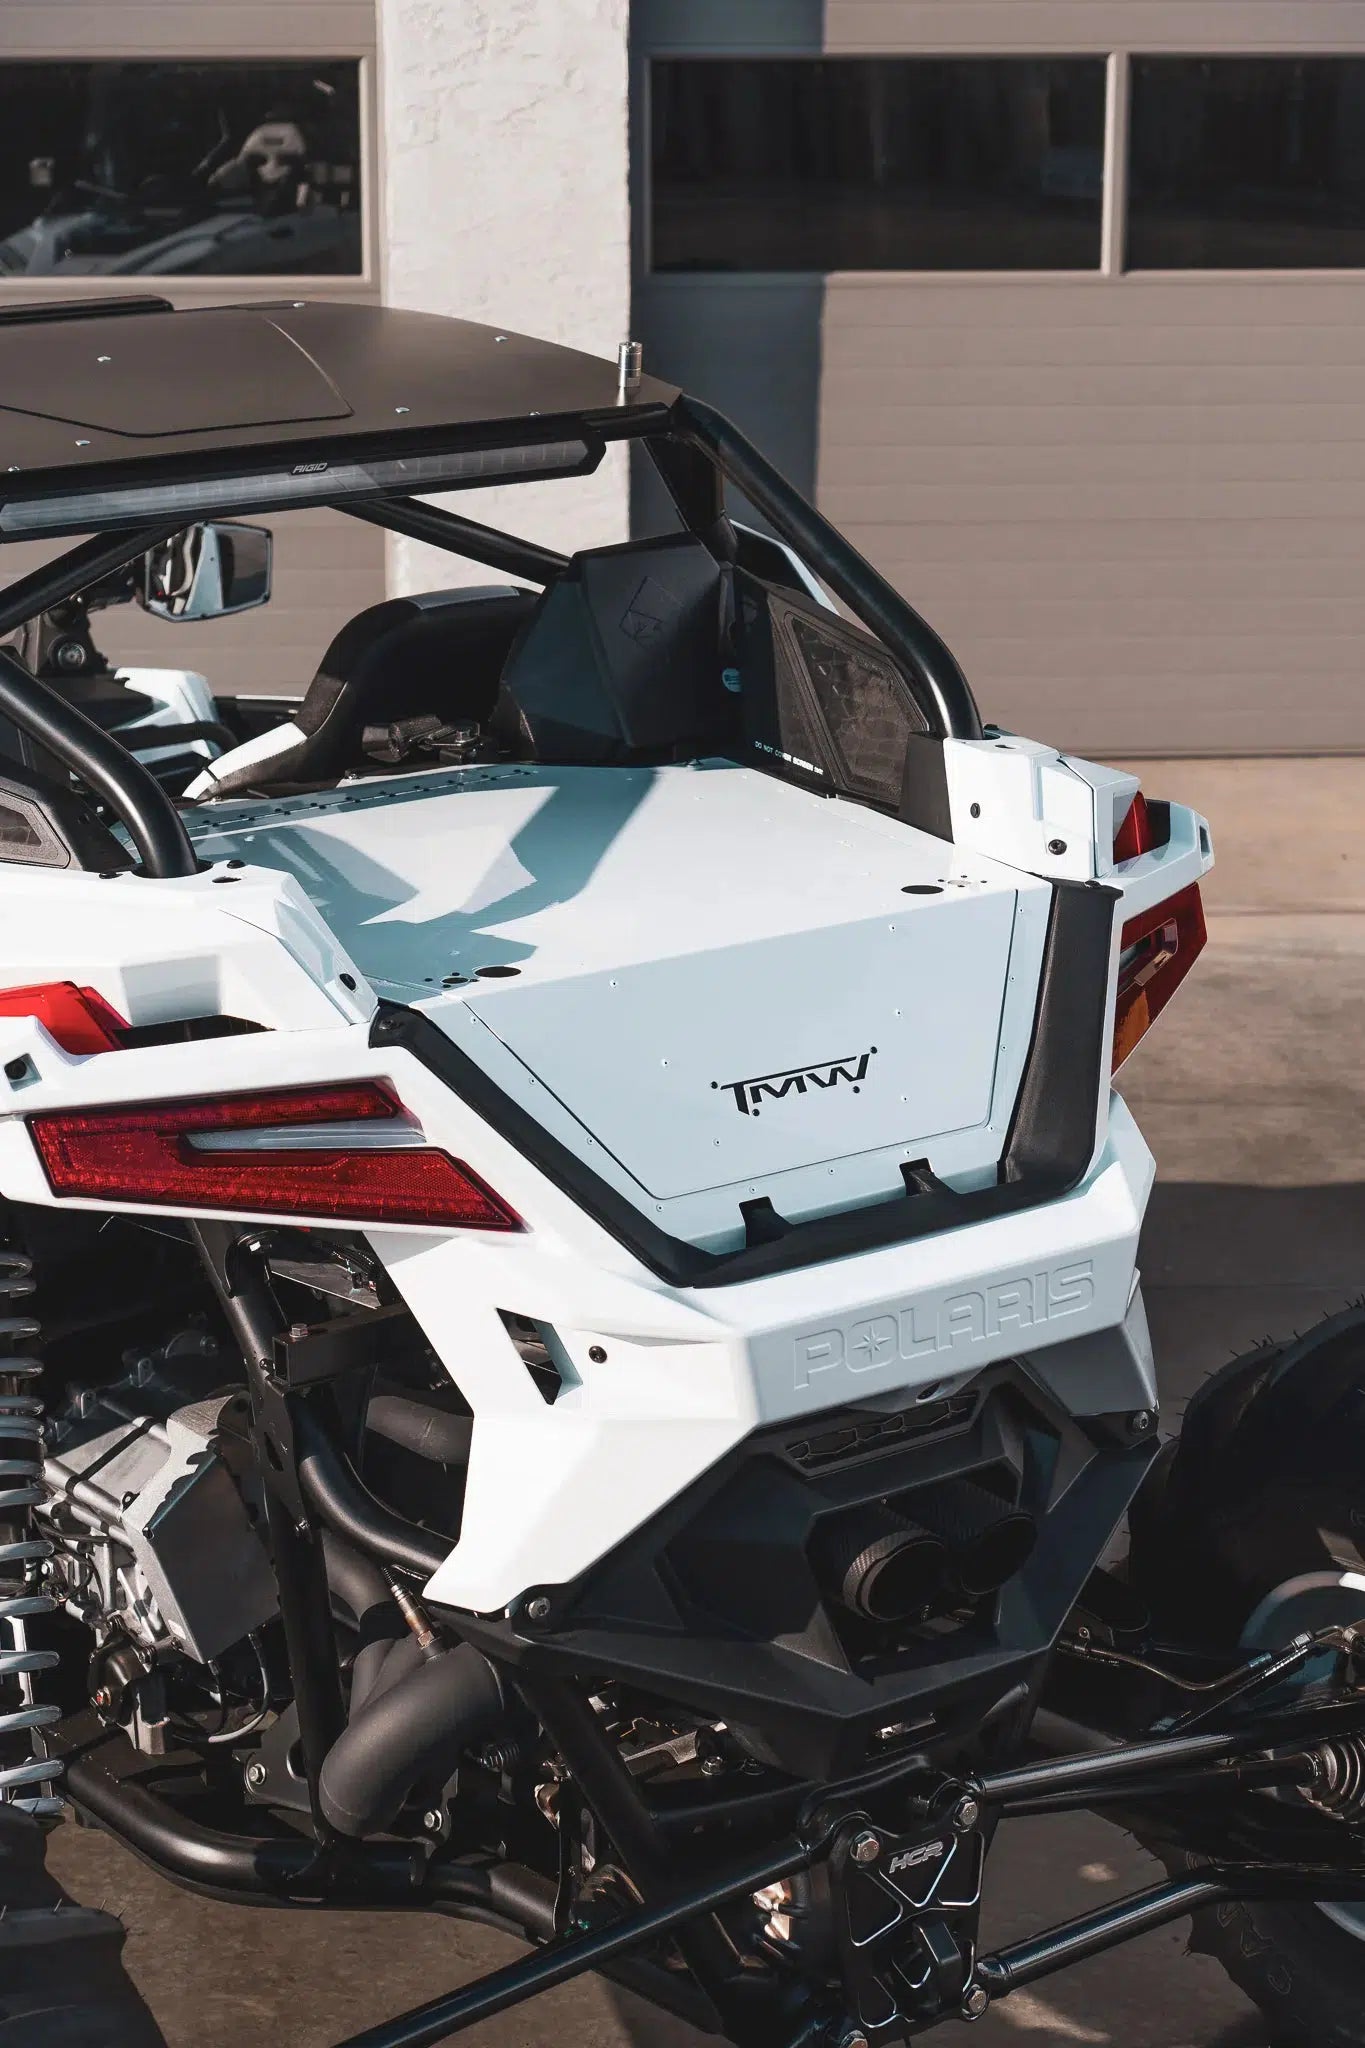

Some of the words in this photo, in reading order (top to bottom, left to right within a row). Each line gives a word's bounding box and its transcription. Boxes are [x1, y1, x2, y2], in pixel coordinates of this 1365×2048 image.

[292, 462, 328, 474] RIGID
[754, 740, 762, 749] DO
[763, 744, 774, 753] NOT
[720, 1053, 870, 1115] TMW
[794, 1259, 1094, 1390] POLARIS
[889, 1841, 943, 1874] HCR
